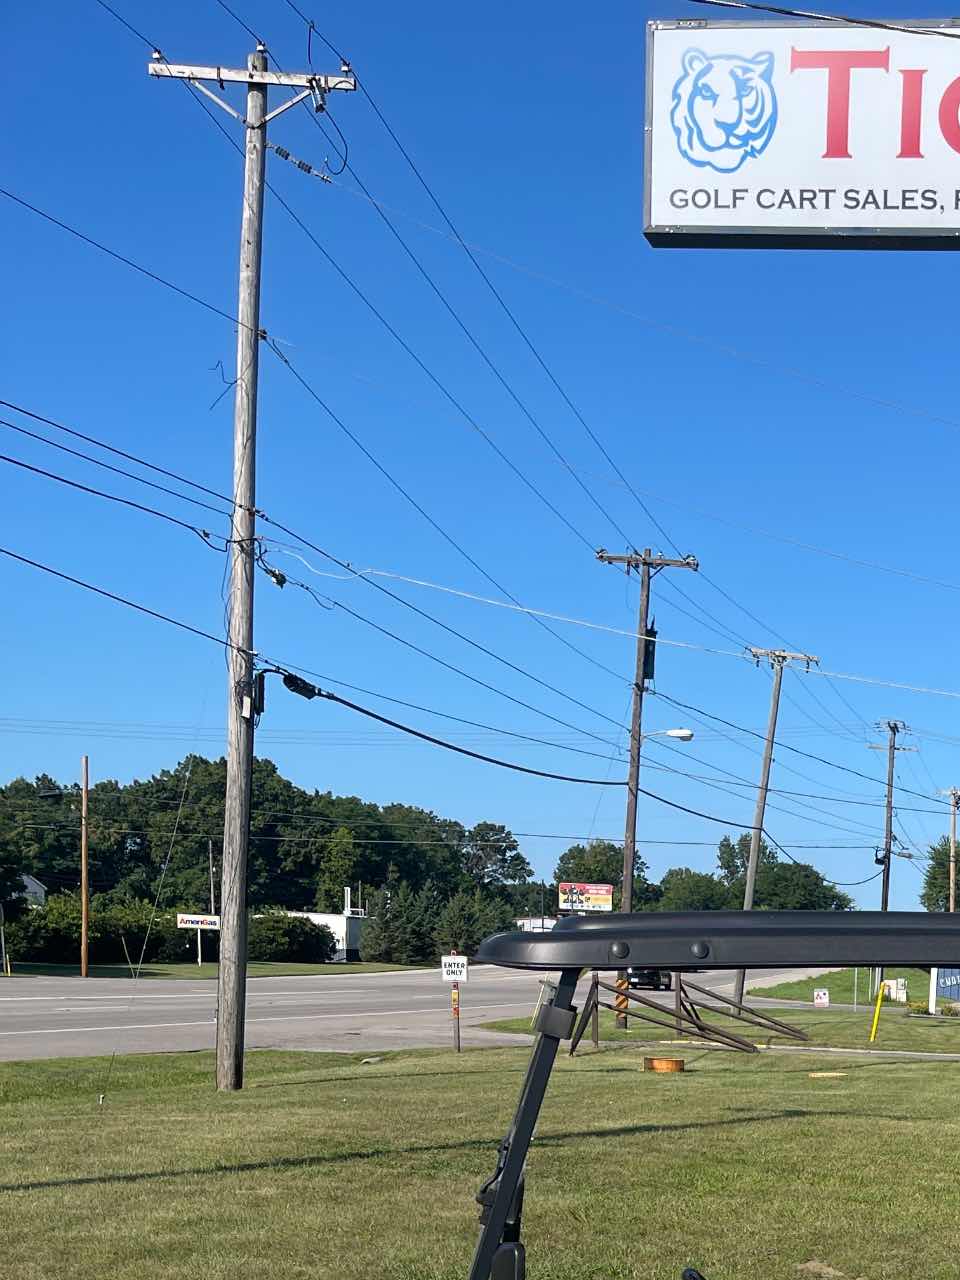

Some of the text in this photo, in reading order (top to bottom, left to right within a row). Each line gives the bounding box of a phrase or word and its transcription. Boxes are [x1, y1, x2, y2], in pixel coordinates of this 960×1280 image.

[669, 188, 749, 210] GOLF
[756, 188, 837, 211] CART
[843, 188, 945, 214] SALES,
[180, 918, 217, 926] AmeriGas
